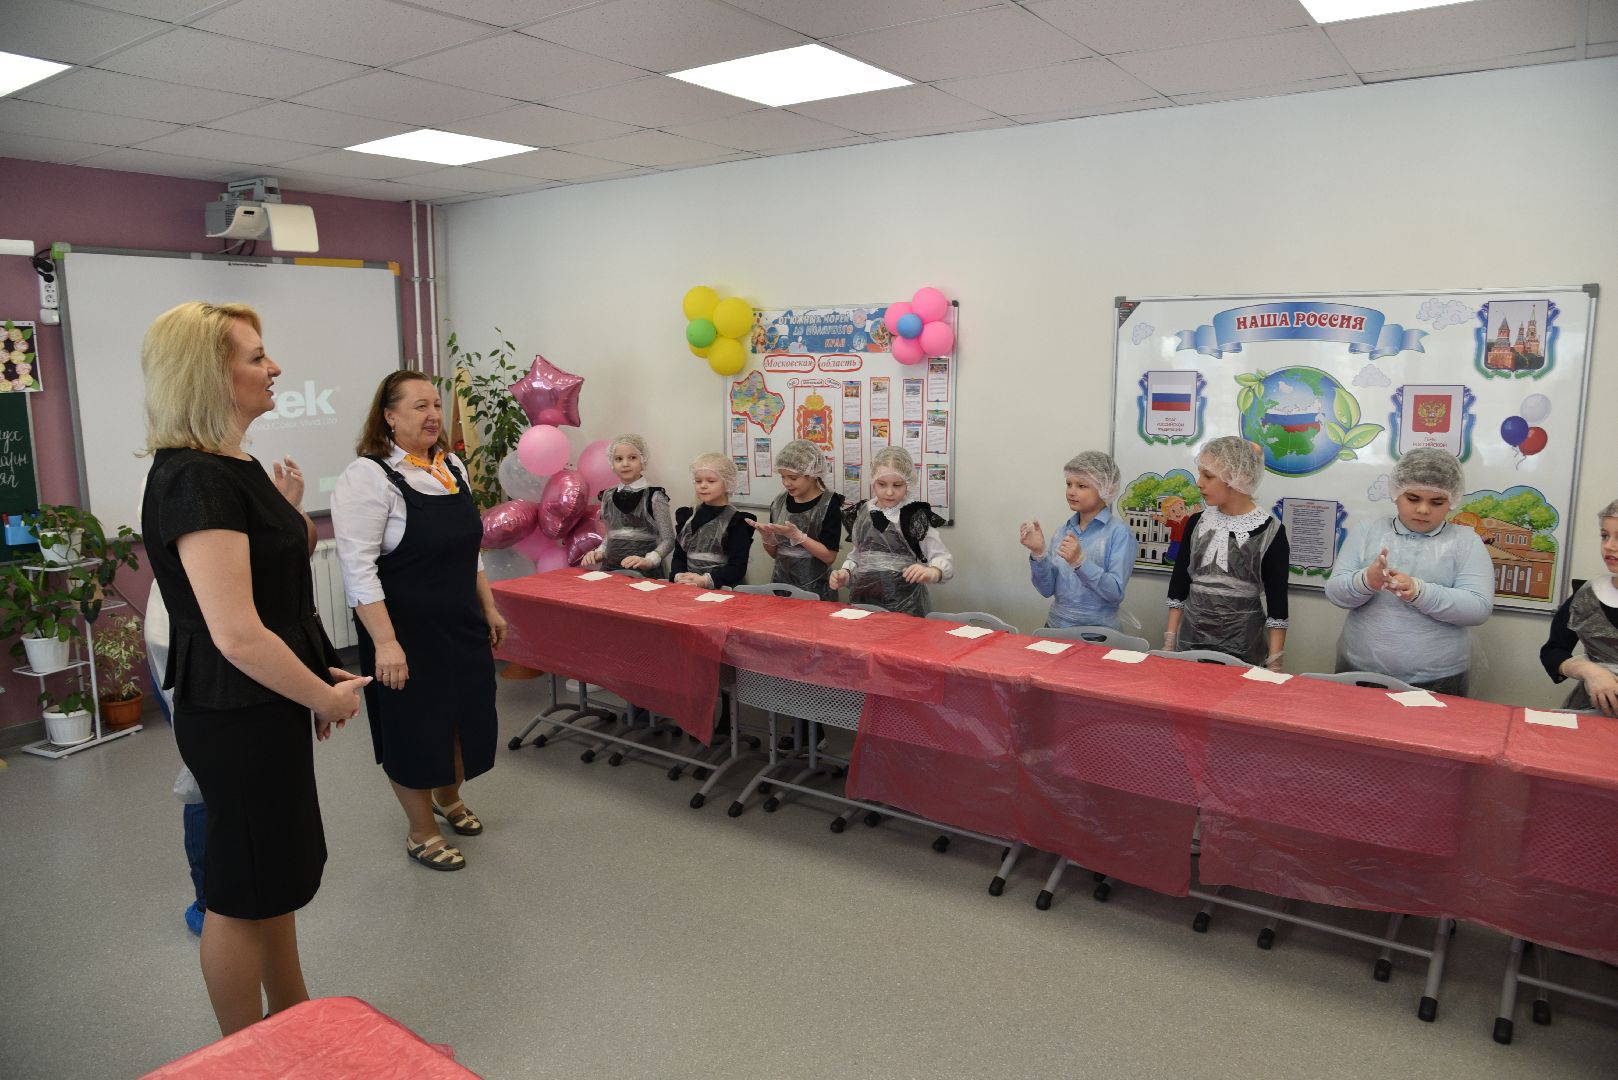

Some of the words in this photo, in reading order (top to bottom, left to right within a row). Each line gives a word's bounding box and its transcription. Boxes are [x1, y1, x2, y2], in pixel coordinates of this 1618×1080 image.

[1236, 312, 1290, 330] НАША
[1295, 312, 1366, 330] РОССИЯ
[765, 359, 813, 368] Московская
[821, 358, 857, 368] область
